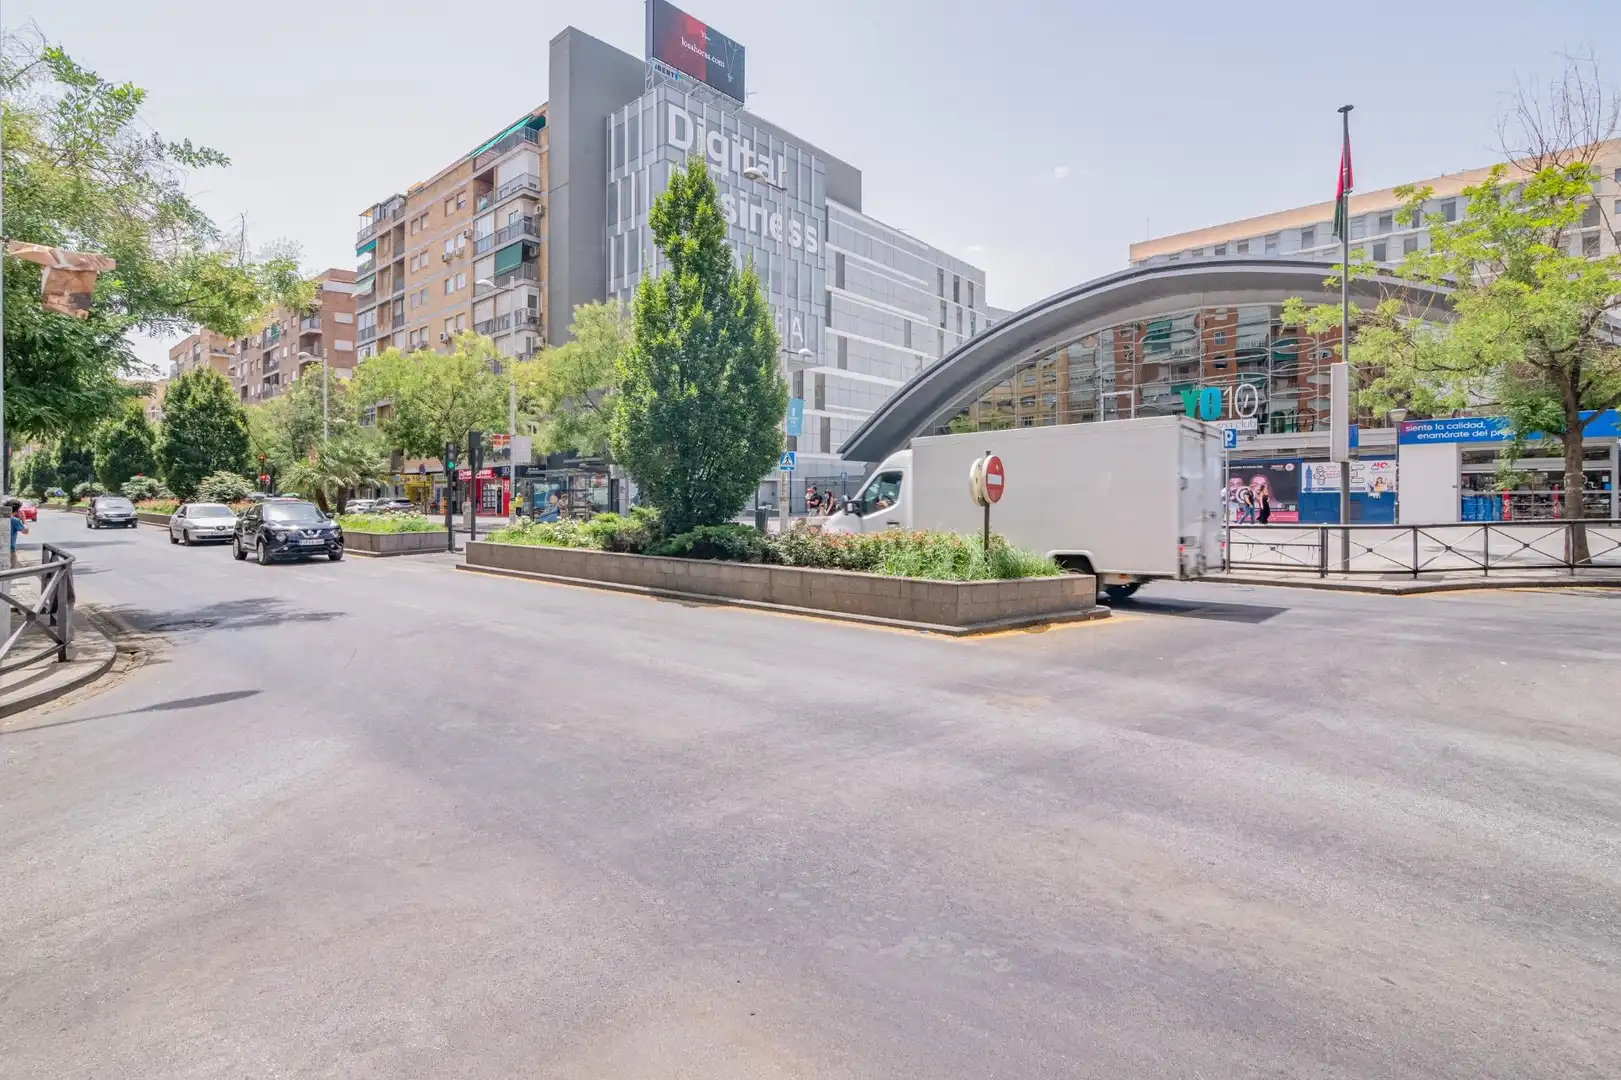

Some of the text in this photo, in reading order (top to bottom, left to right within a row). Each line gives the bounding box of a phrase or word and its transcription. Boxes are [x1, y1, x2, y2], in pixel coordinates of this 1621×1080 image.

[681, 37, 725, 68] losahoras.com
[668, 103, 785, 187] Digital
[1180, 383, 1258, 421] YO10
[1405, 421, 1486, 432] siente la calidad,
[1417, 431, 1469, 440] enamórate
[1472, 429, 1488, 437] del
